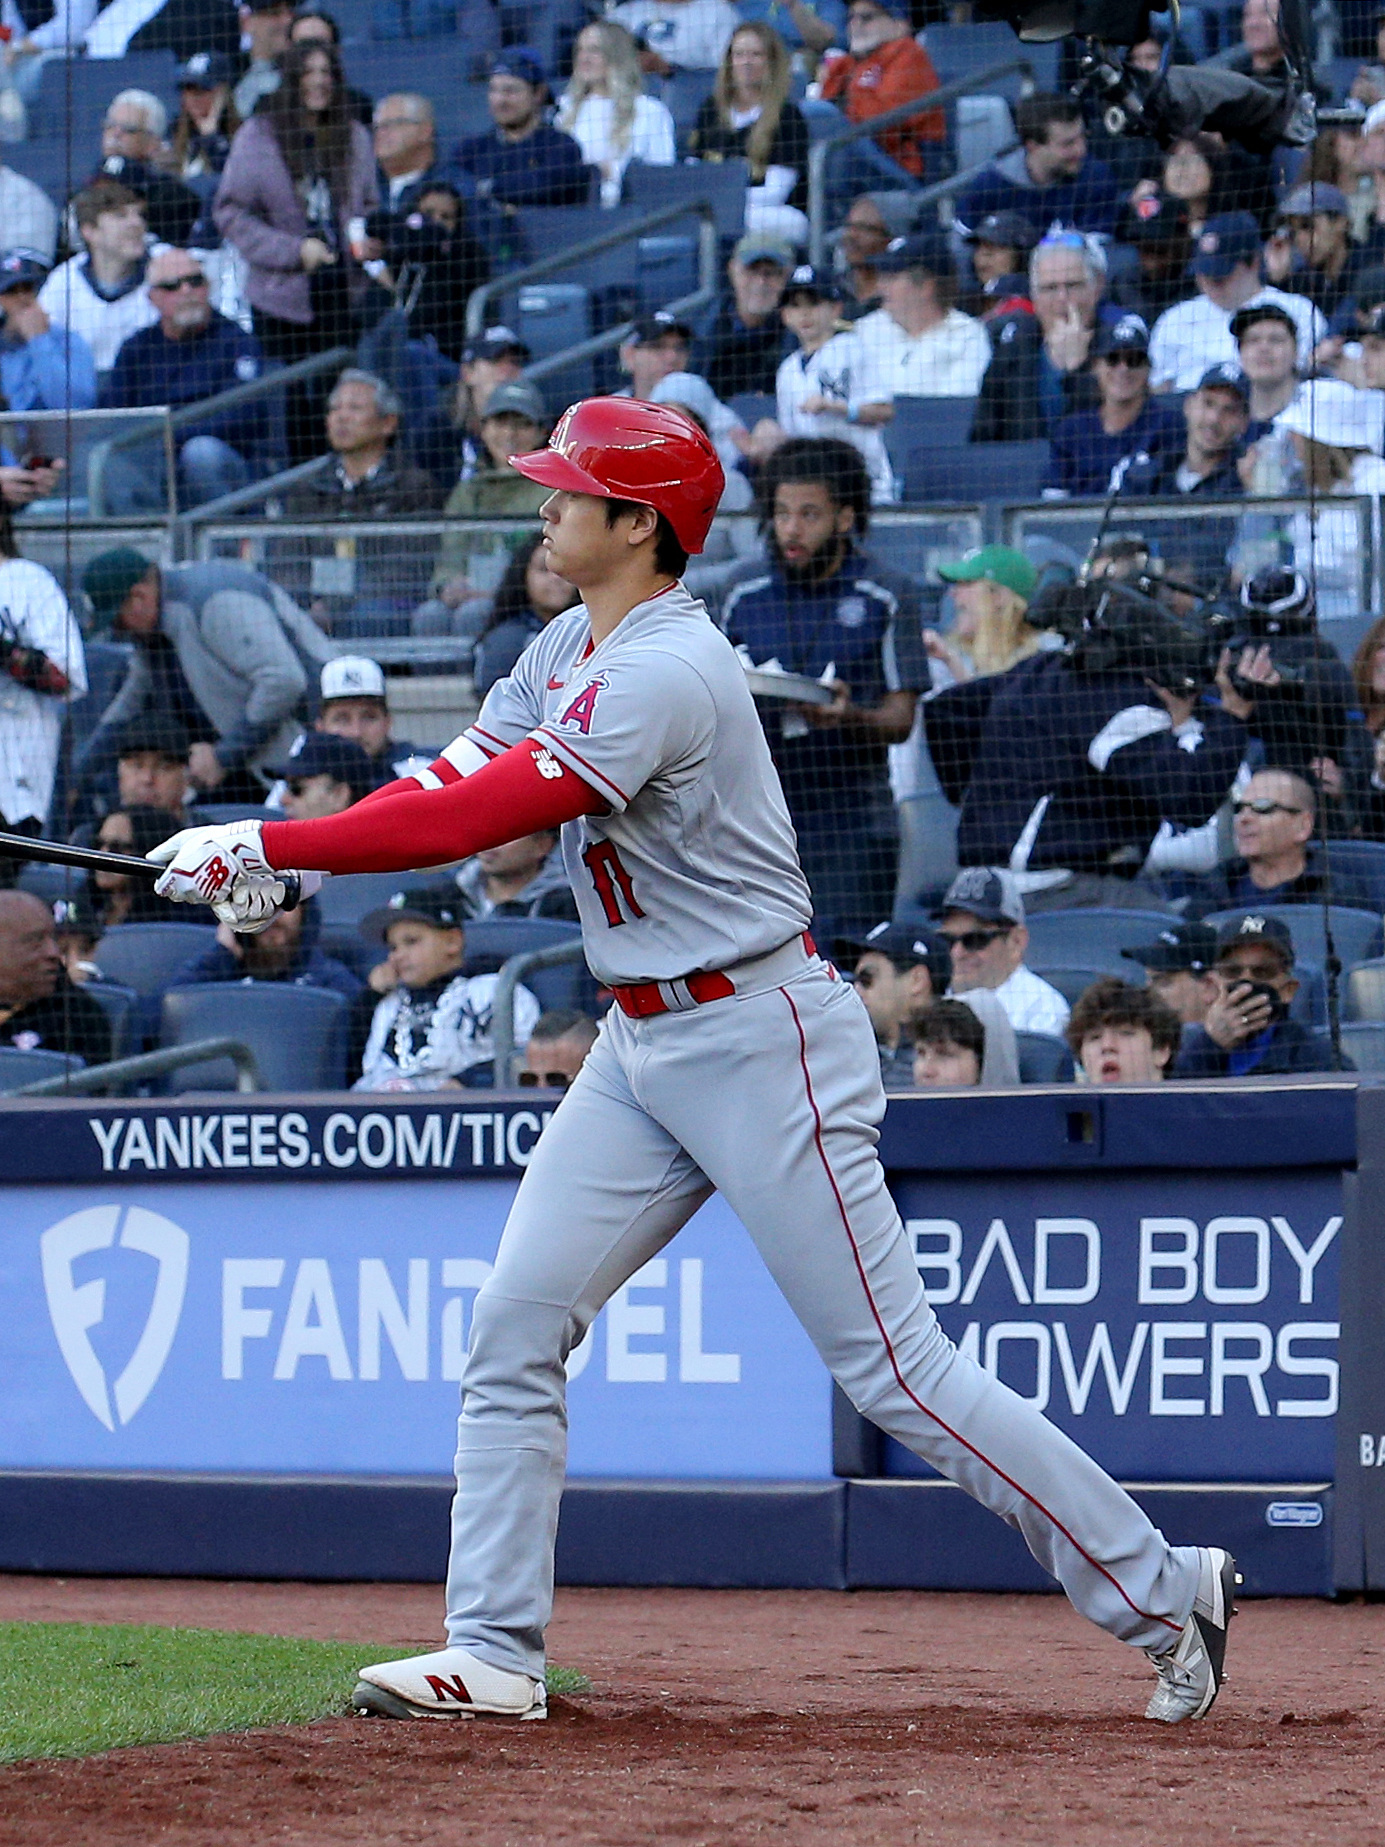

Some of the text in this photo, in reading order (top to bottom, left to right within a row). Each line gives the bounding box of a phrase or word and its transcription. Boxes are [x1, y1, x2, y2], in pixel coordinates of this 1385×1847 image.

[560, 672, 606, 735] A
[906, 1216, 1343, 1304] BAD BOY
[222, 1258, 741, 1383] FANEL
